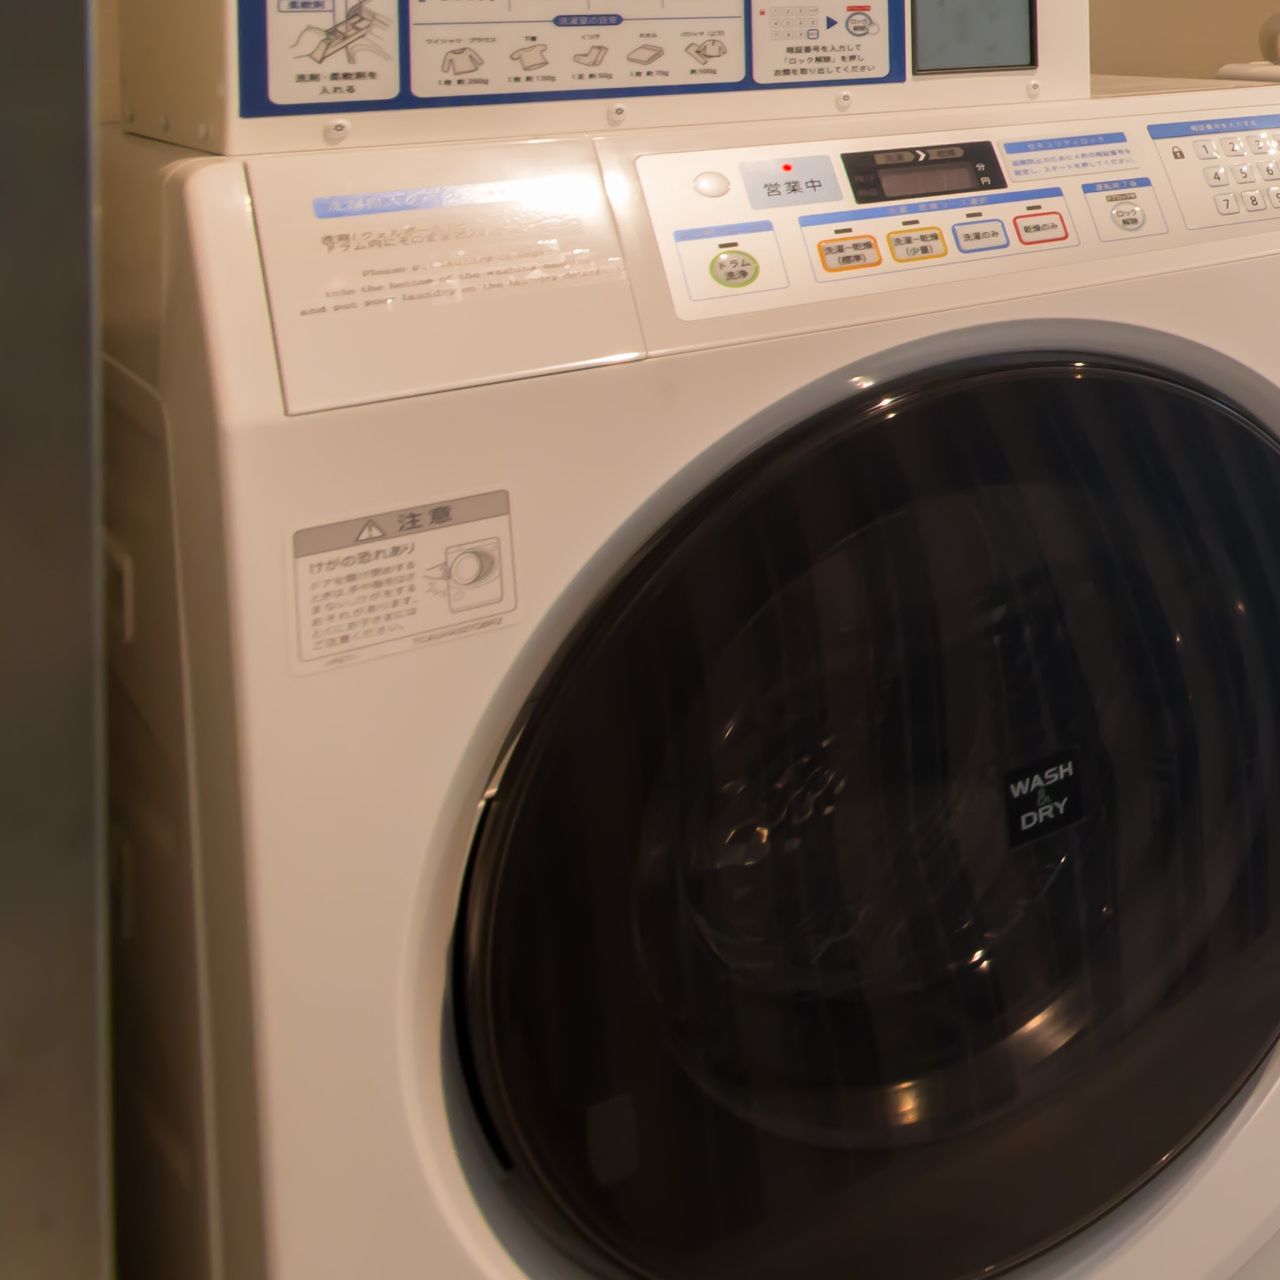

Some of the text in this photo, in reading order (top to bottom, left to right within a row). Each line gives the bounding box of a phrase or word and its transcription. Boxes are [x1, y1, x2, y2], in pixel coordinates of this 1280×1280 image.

[764, 178, 822, 197] 営業中
[962, 230, 999, 242] 洗濯のみ
[1023, 223, 1058, 234] 乾燥のみ
[718, 258, 752, 270] ドラム
[399, 506, 452, 532] 注意
[1009, 760, 1074, 799] WASH
[1020, 796, 1069, 831] DRY
